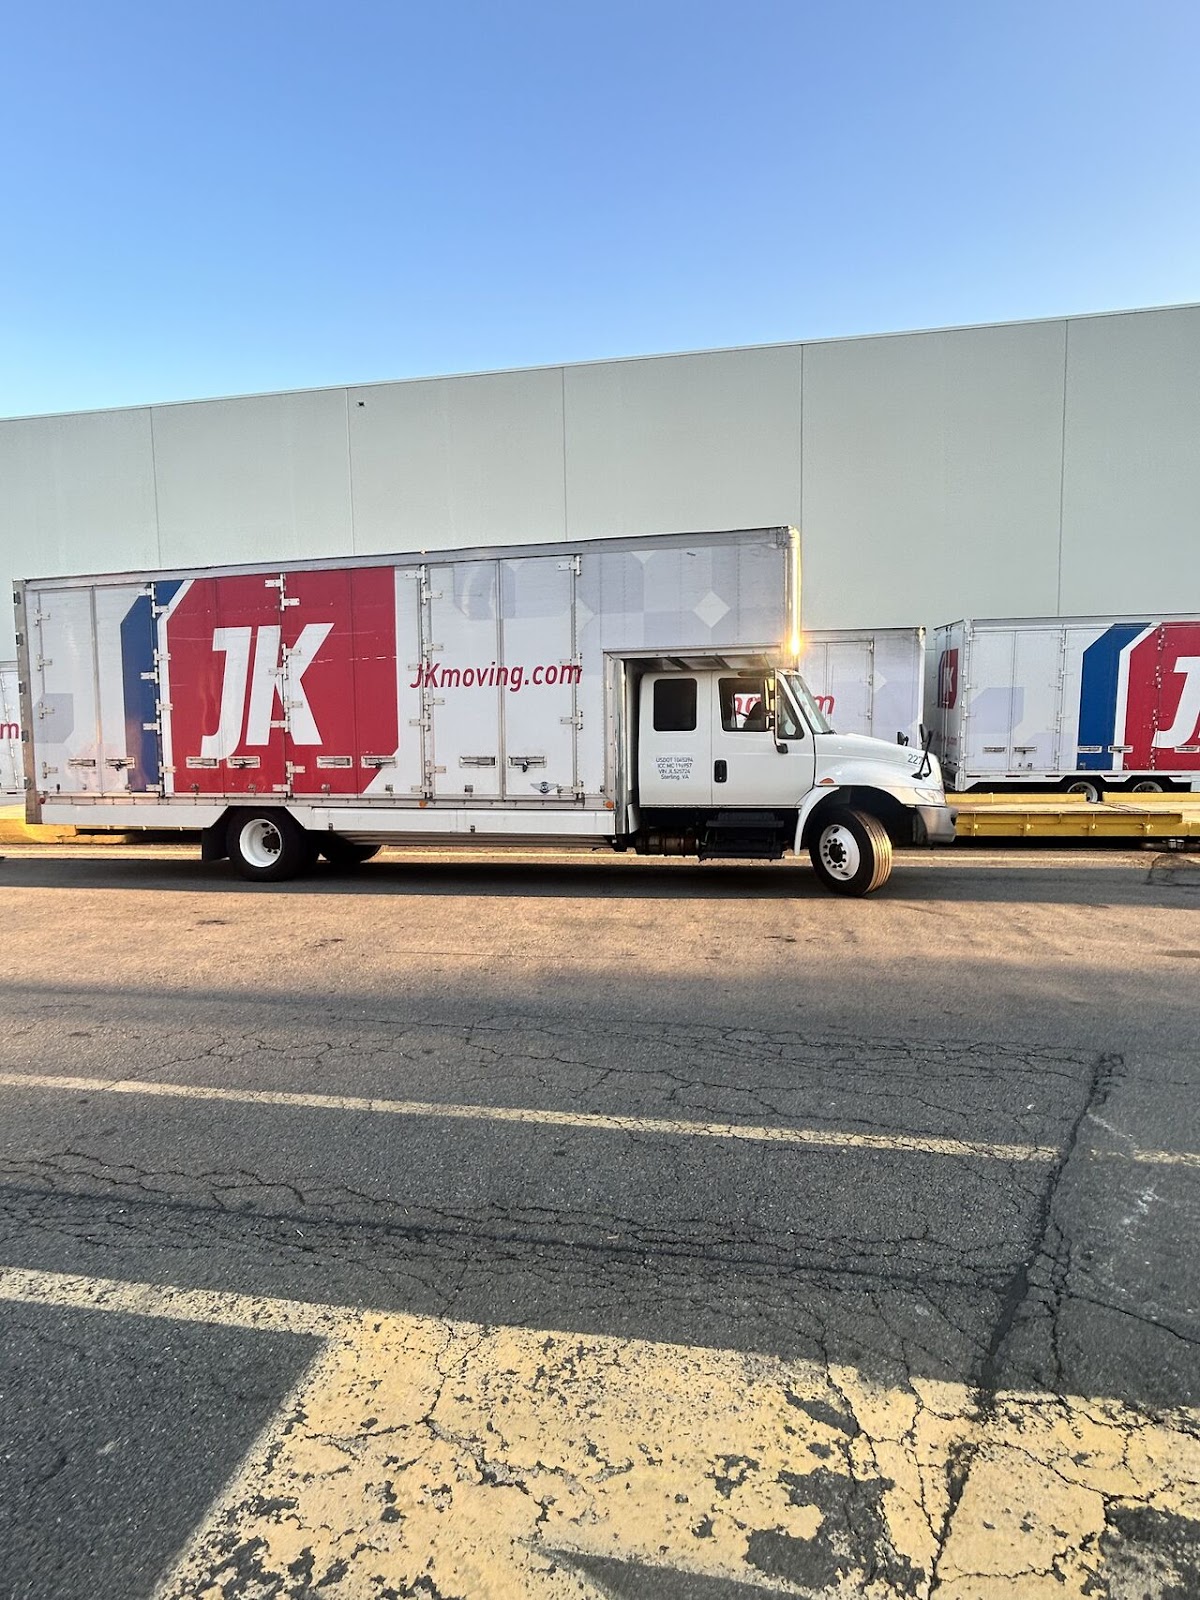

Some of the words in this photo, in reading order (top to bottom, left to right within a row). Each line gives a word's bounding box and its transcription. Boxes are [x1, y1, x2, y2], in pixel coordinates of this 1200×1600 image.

[201, 622, 334, 759] JK
[409, 662, 583, 692] JKmoving.com
[1152, 656, 1200, 748] J
